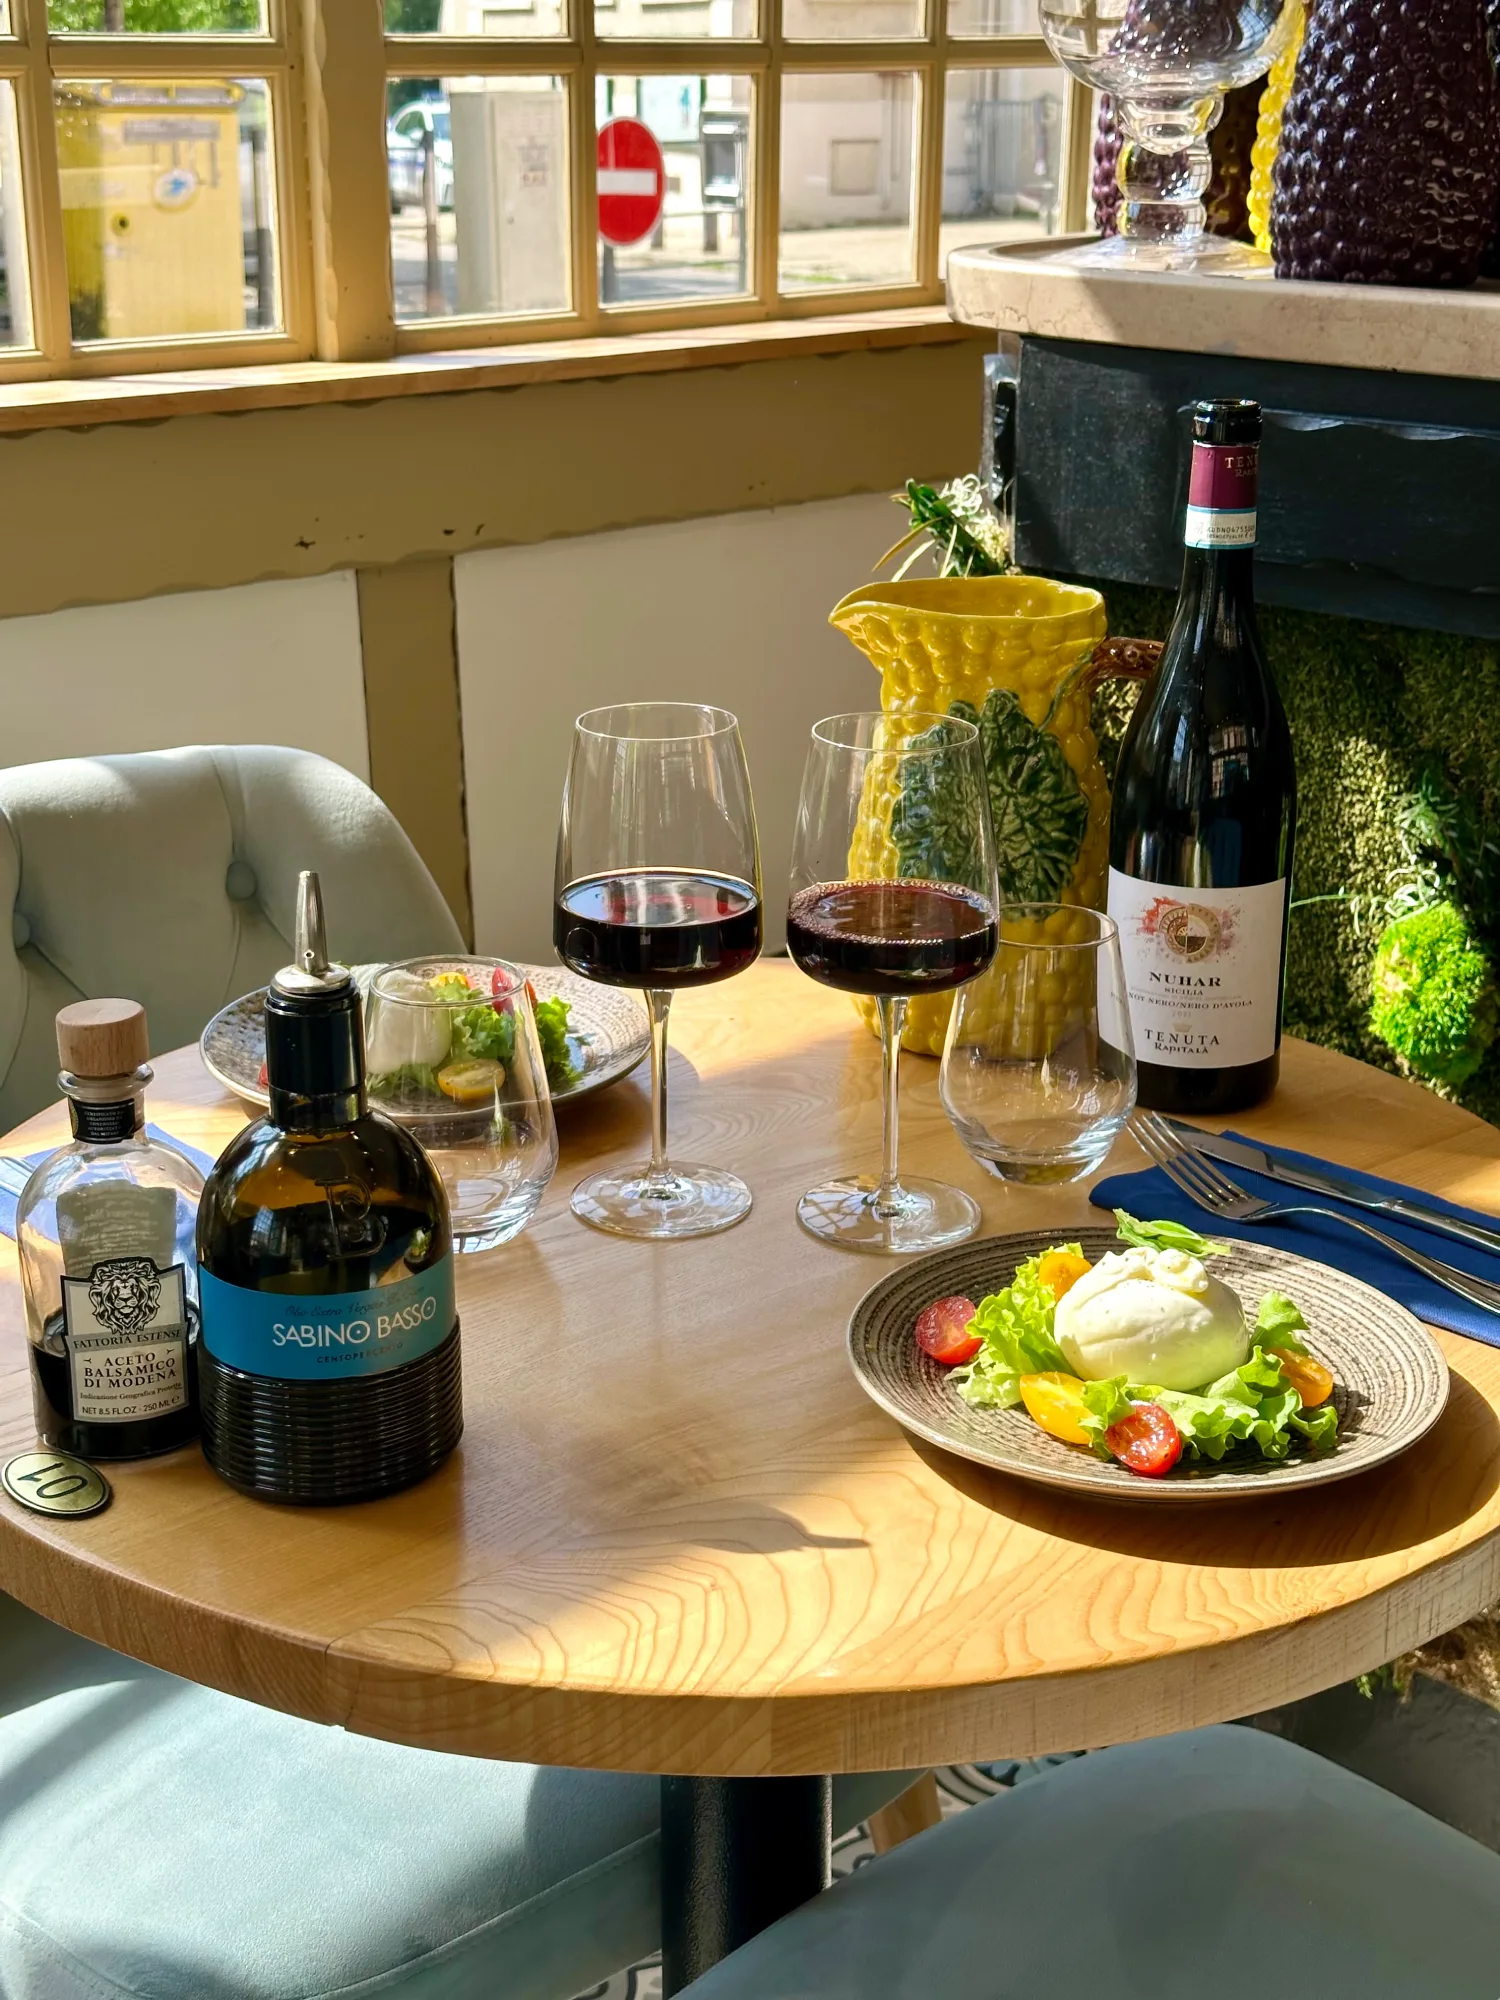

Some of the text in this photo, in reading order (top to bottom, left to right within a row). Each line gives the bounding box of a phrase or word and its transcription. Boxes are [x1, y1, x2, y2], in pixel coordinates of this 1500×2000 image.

[1149, 971, 1221, 987] NUHAR
[1164, 987, 1204, 996] SICILIA
[1144, 1028, 1220, 1046] TENUTA
[272, 1320, 371, 1347] SABINO
[377, 1296, 437, 1339] BASSO
[73, 1329, 181, 1349] FATTORIA ESTENSE
[84, 1358, 175, 1378] BALSAMICO
[104, 1352, 155, 1367] ACETO
[84, 1369, 177, 1388] DI MODENA
[80, 1392, 117, 1400] Indicazione
[119, 1390, 155, 1400] Geografica
[82, 1406, 97, 1415] NET
[98, 1407, 110, 1415] 8.5
[143, 1403, 157, 1412] 250
[158, 1400, 170, 1409] ML
